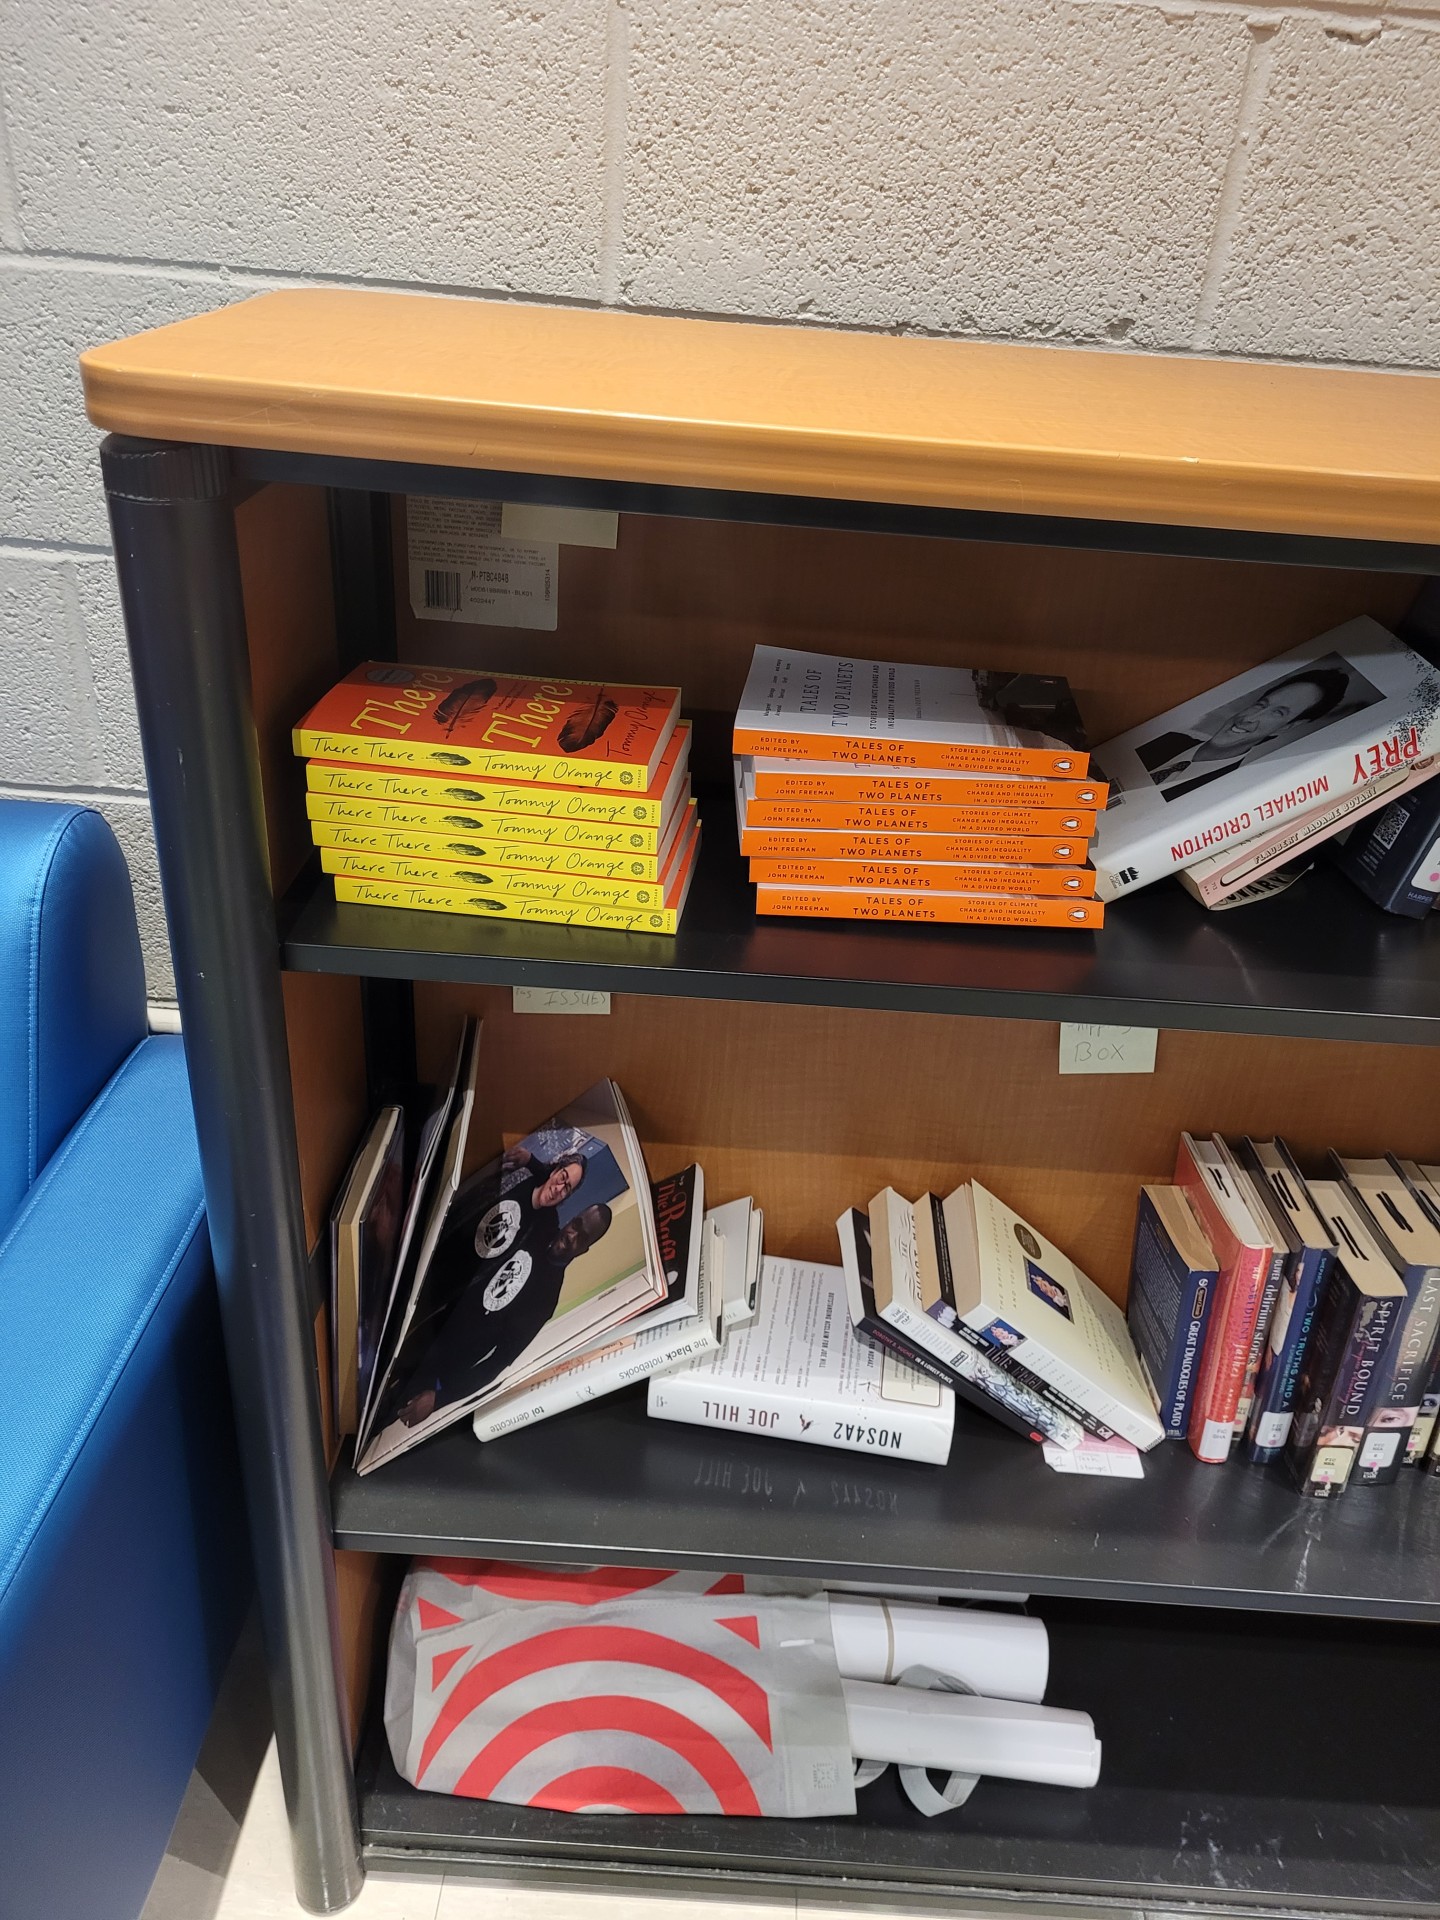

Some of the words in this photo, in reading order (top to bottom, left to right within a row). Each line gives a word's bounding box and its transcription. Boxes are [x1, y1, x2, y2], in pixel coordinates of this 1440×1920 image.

[806, 668, 822, 680] OF
[834, 662, 854, 701] PLANETS
[350, 672, 453, 734] There
[624, 690, 666, 722] Orange
[800, 683, 821, 712] TALES
[481, 685, 573, 748] There
[832, 703, 850, 727] TWO
[310, 737, 358, 755] There
[364, 742, 414, 761] There
[606, 719, 657, 757] Tommy
[760, 736, 787, 744] EDITED
[772, 746, 808, 754] FREEMAN
[845, 740, 882, 750] TALES
[888, 743, 904, 751] OF
[831, 750, 858, 760] TWO
[863, 752, 916, 764] PLANETS
[1352, 726, 1422, 785] PREY
[479, 754, 546, 779] Tommy
[553, 761, 612, 786] Orange
[324, 773, 373, 791] There
[379, 778, 429, 797] There
[858, 791, 885, 799] TWO
[889, 791, 942, 801] PLANETS
[871, 779, 909, 789] TALES
[914, 781, 931, 789] OF
[493, 790, 561, 815] Tommy
[566, 797, 626, 821] Orange
[1254, 775, 1330, 821] MICHAEL
[324, 802, 372, 819] There
[378, 806, 427, 824] There
[844, 818, 871, 826] TWO
[876, 819, 928, 829] PLANETS
[858, 807, 895, 816] TALES
[900, 808, 917, 817] OF
[329, 828, 377, 846] There
[382, 834, 431, 852] There
[491, 818, 558, 842] Tommy
[564, 824, 623, 849] Orange
[852, 836, 889, 845] TALES
[894, 837, 910, 846] OF
[1171, 812, 1251, 862] CRICHTON
[1253, 833, 1299, 864] FLAUBERT
[1301, 810, 1342, 837] MADAME
[493, 845, 560, 870] Tommy
[565, 852, 624, 876] Orange
[839, 847, 865, 856] TWO
[870, 848, 922, 857] PLANETS
[338, 856, 385, 873] There
[390, 861, 439, 880] There
[861, 865, 897, 874] TALES
[902, 866, 919, 875] OF
[500, 873, 566, 898] Tommy
[572, 881, 629, 905] Orange
[847, 875, 874, 884] TWO
[878, 877, 930, 887] PLANETS
[352, 885, 398, 901] There
[404, 889, 452, 907] There
[865, 896, 902, 906] TALES
[907, 897, 923, 906] OF
[514, 900, 580, 923] Tommy
[585, 906, 643, 929] Orange
[852, 907, 879, 916] TWO
[883, 908, 935, 918] PLANETS
[1074, 1041, 1124, 1063] BOX
[1271, 1259, 1284, 1281] OLIVER
[1316, 1257, 1327, 1284] SHEPARD
[1420, 1276, 1440, 1313] LAST
[1257, 1284, 1279, 1330] delirium
[1188, 1320, 1201, 1344] GREAT
[1302, 1311, 1314, 1333] TWO
[1366, 1301, 1393, 1352] SPIRIT
[665, 1345, 693, 1361] black
[694, 1337, 709, 1349] the
[1249, 1329, 1264, 1366] stories
[618, 1356, 664, 1380] notebooks
[872, 1329, 892, 1344] DOROTHY
[924, 1362, 940, 1375] LONELY
[939, 1370, 954, 1384] PLACE
[1178, 1345, 1196, 1389] DIALOGUES
[1290, 1336, 1308, 1376] TRUTHS
[1391, 1320, 1428, 1401] SACRIFICE
[1176, 1389, 1188, 1399] OF
[1284, 1377, 1296, 1398] AND
[1346, 1360, 1375, 1415] BOUND
[490, 1411, 530, 1434] derricotte
[702, 1401, 740, 1423] HILL
[747, 1408, 780, 1429] JOE
[1171, 1398, 1185, 1426] PLATO
[833, 1422, 902, 1449] NOS4A2
